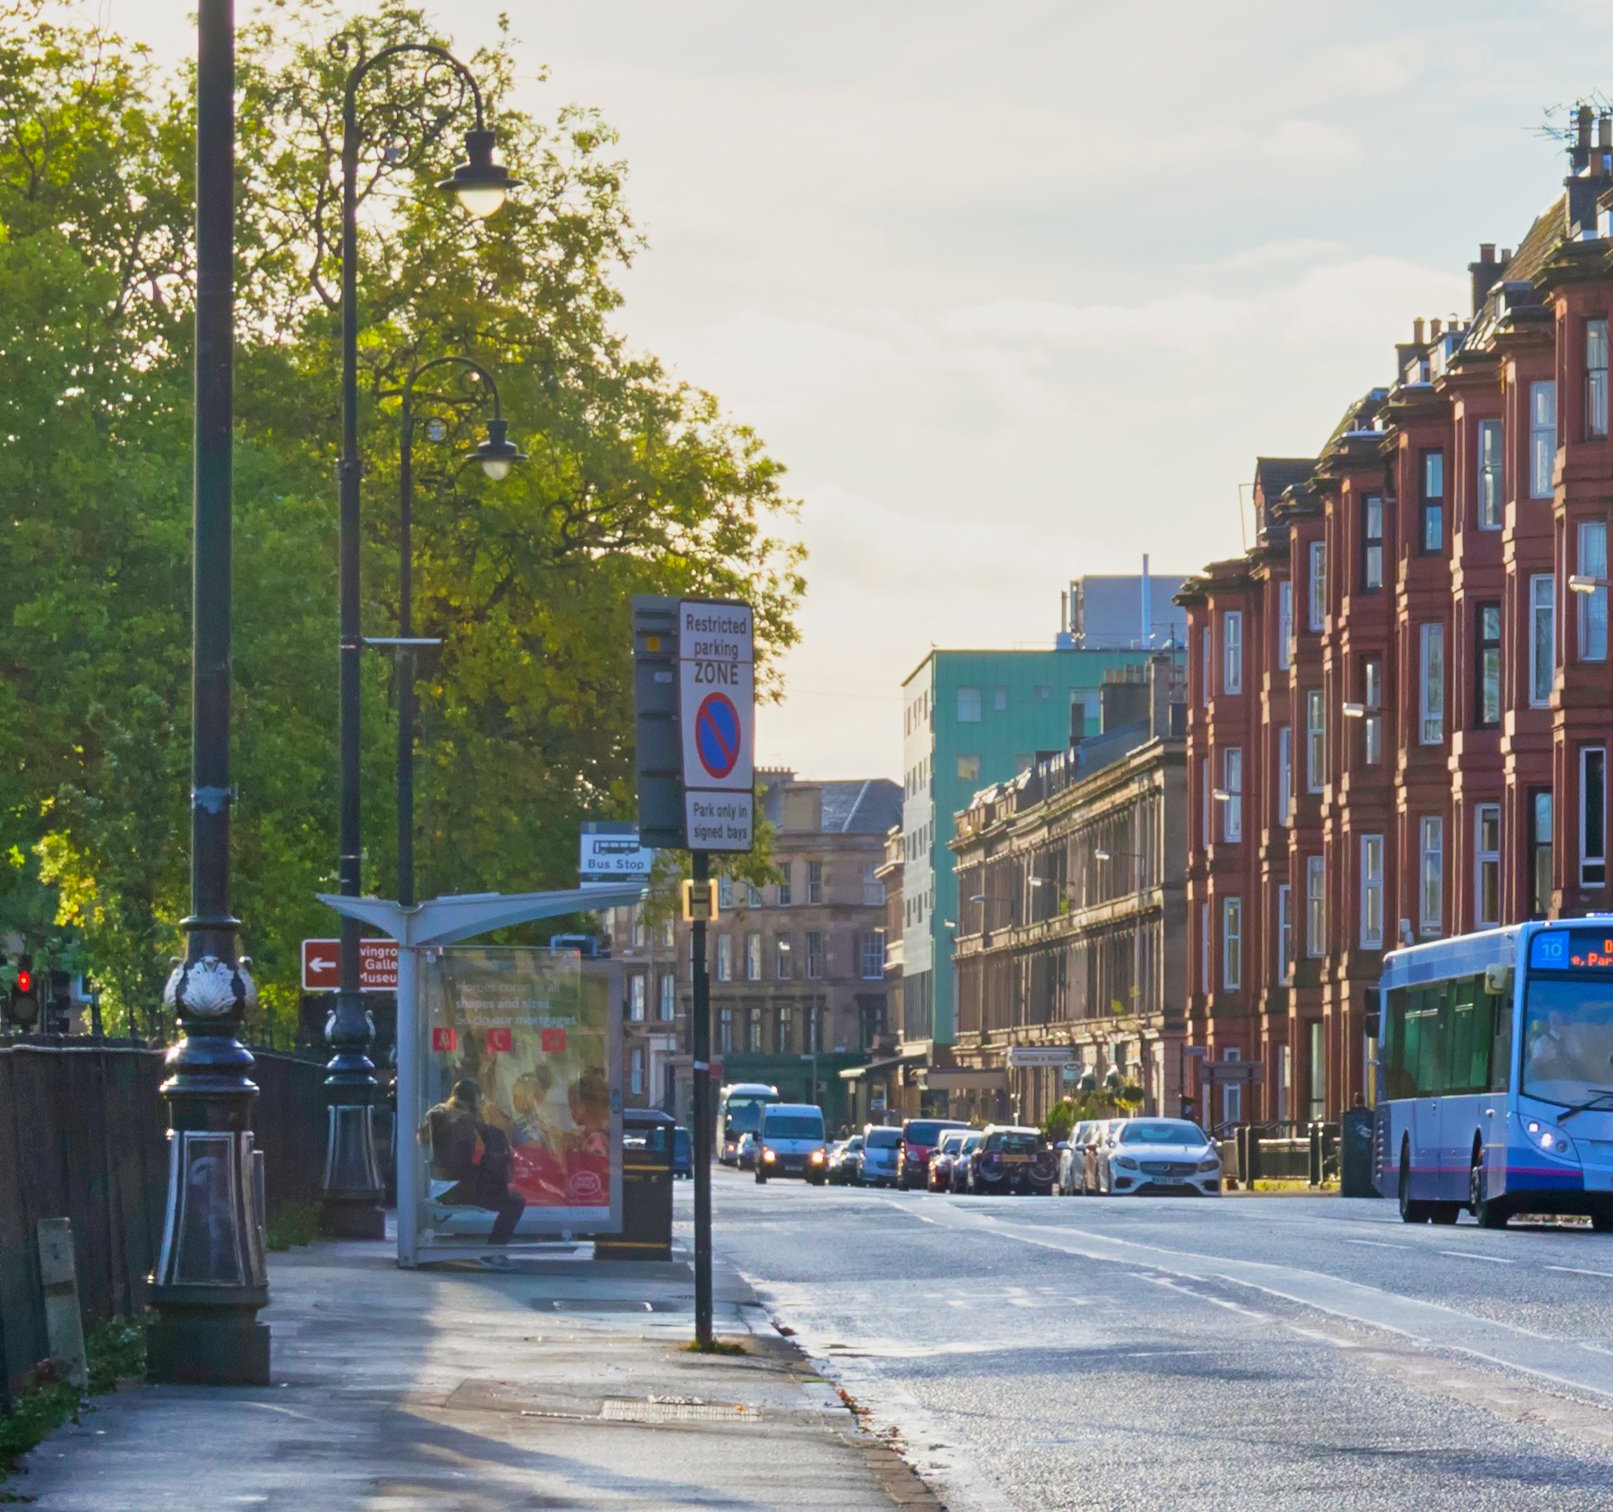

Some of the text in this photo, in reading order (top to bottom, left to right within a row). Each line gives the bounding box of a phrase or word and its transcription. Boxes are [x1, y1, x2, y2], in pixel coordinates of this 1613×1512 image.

[686, 613, 747, 634] Restricted
[694, 638, 739, 660] parking
[694, 662, 739, 685] ZONE
[693, 802, 748, 820] Park only in
[694, 824, 748, 842] signed bays
[588, 858, 645, 870] Bus Stop
[1541, 943, 1563, 957] 10
[365, 959, 398, 970] Galle
[497, 997, 519, 1009] and
